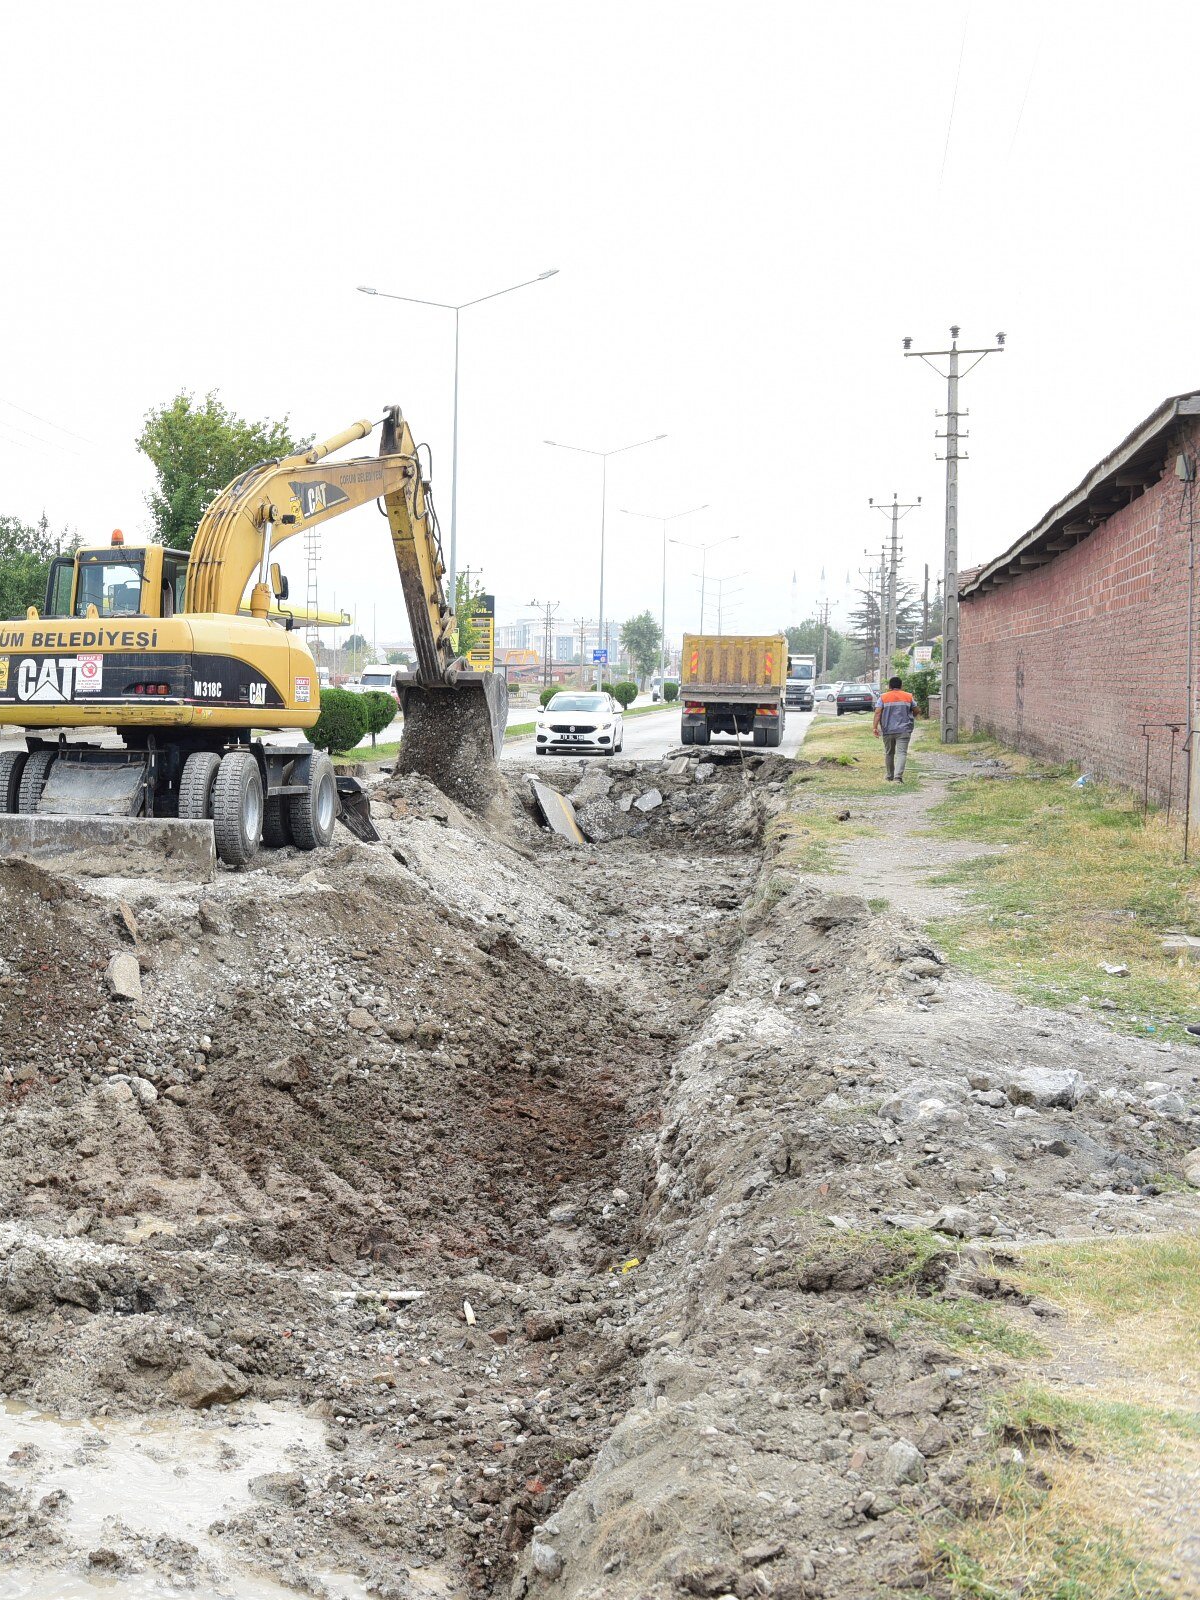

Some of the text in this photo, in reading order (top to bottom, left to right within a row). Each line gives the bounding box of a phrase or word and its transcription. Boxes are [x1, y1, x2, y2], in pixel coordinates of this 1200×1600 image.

[307, 483, 327, 514] CAT
[31, 628, 157, 648] BELEDİYESİ
[18, 659, 77, 701] CAT
[249, 683, 267, 705] CAT
